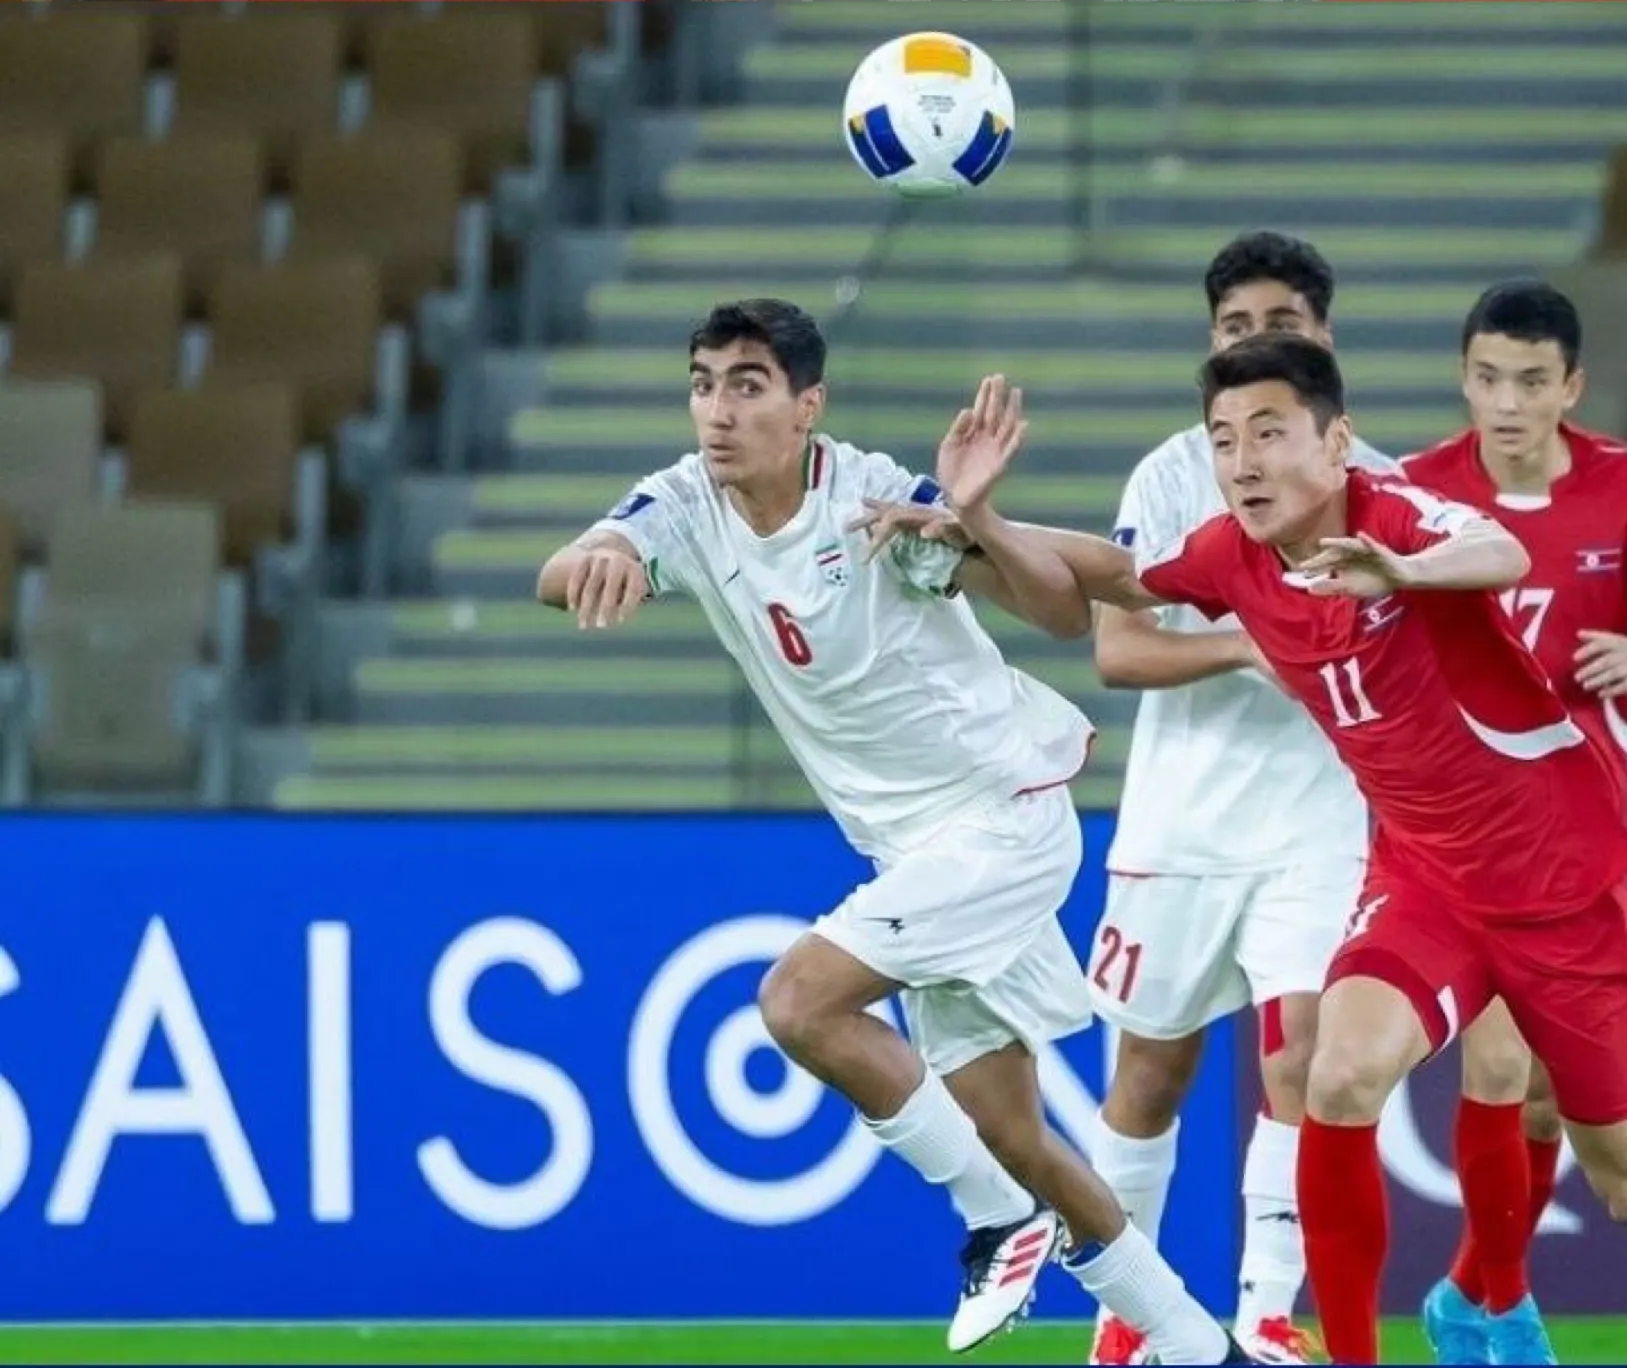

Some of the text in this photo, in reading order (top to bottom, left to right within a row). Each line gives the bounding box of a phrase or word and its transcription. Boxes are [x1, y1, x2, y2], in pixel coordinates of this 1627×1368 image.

[768, 601, 814, 667] 6
[1319, 655, 1383, 727] 11
[1094, 925, 1143, 1003] 21
[0, 915, 1122, 1230] AISO
